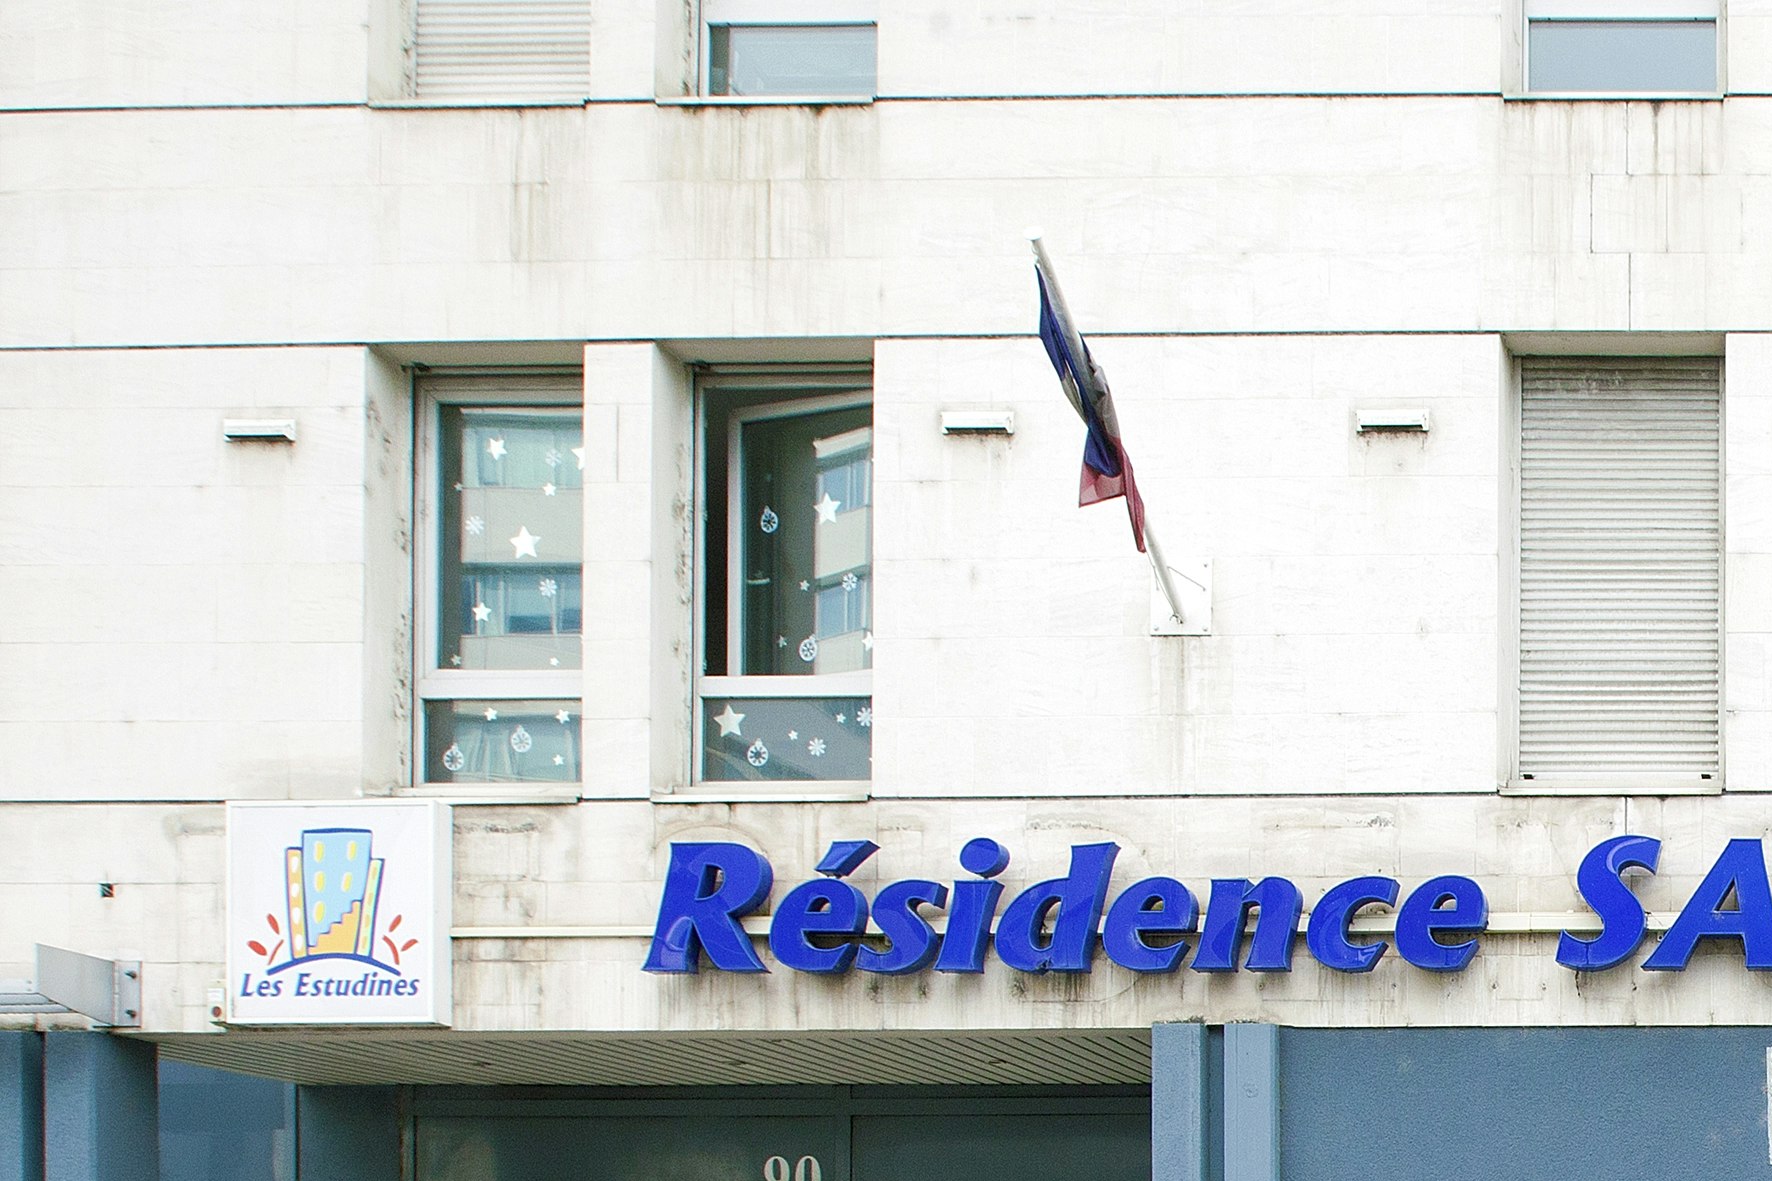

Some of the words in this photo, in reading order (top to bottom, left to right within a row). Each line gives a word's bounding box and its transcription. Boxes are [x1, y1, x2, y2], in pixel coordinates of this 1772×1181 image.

[641, 837, 1490, 975] Résidence
[239, 973, 284, 998] Les
[294, 971, 420, 998] Estudines
